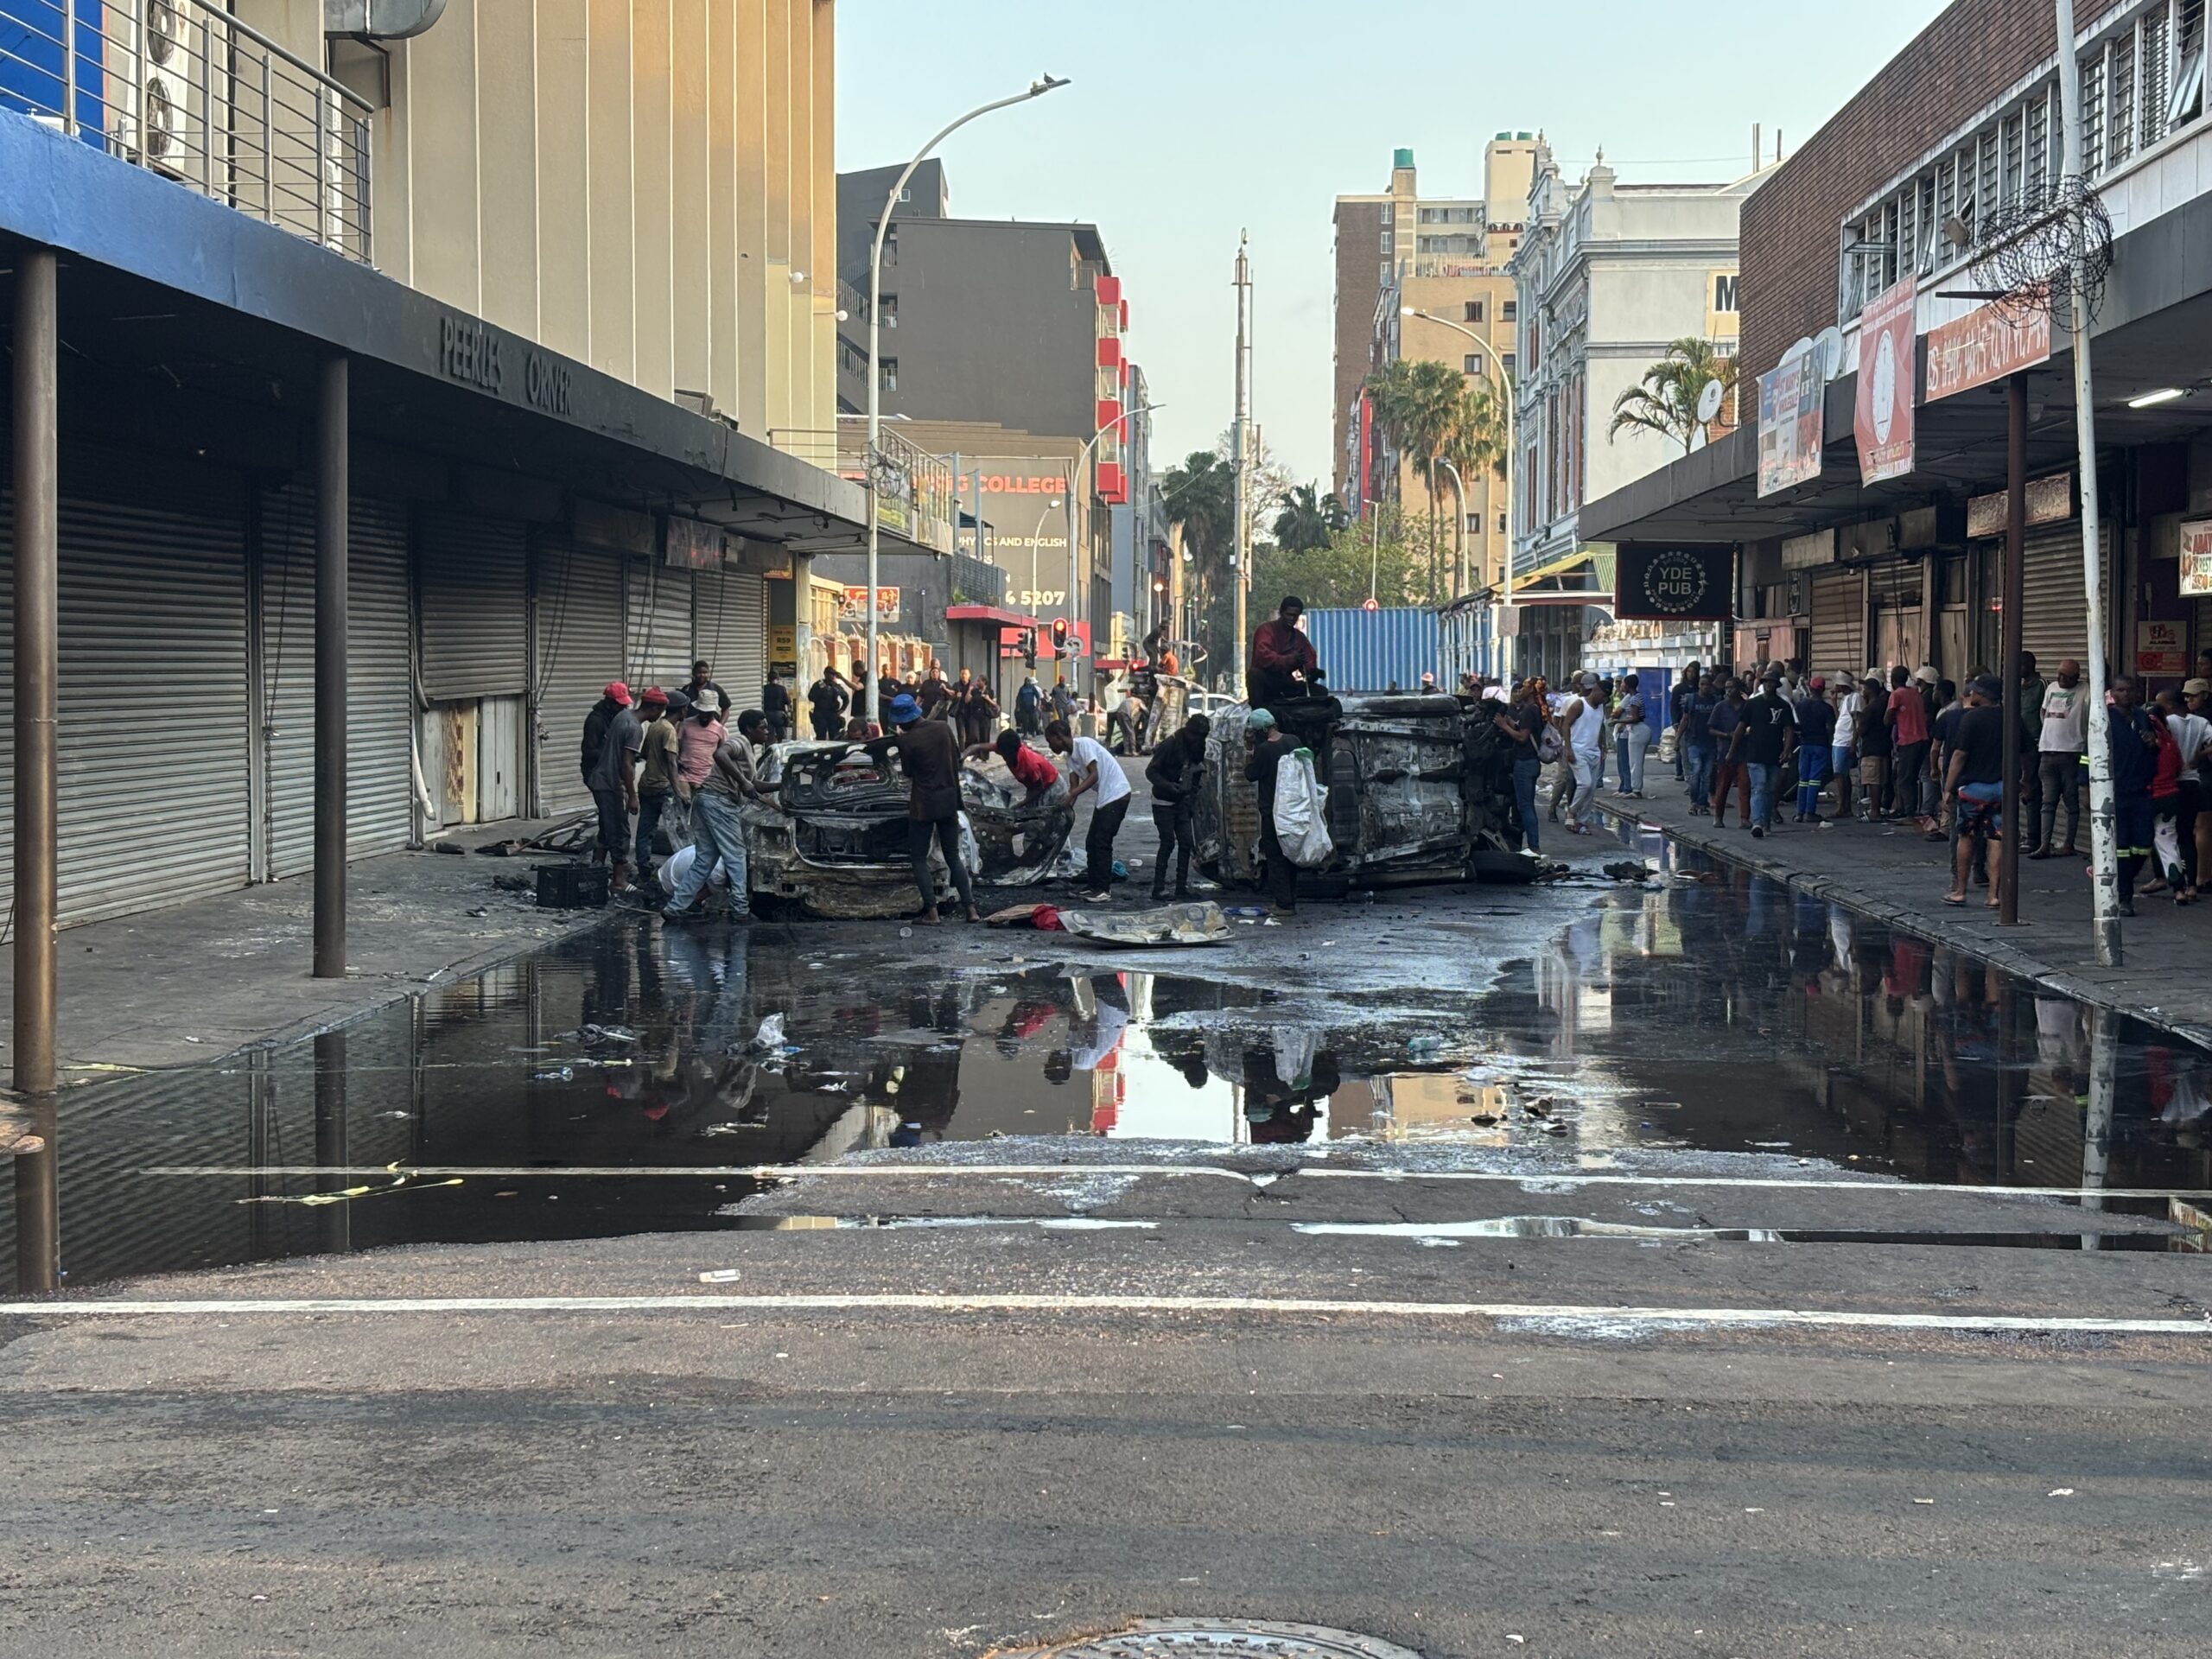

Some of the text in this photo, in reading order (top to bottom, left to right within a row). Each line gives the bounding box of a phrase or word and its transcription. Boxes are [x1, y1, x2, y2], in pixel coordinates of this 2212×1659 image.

[979, 476, 1066, 493] COLLEGE
[999, 537, 1022, 547] AND
[1024, 537, 1067, 547] ENGLISH
[1659, 567, 1692, 580] YDE
[1658, 582, 1692, 595] PUB
[1020, 590, 1065, 605] 5207
